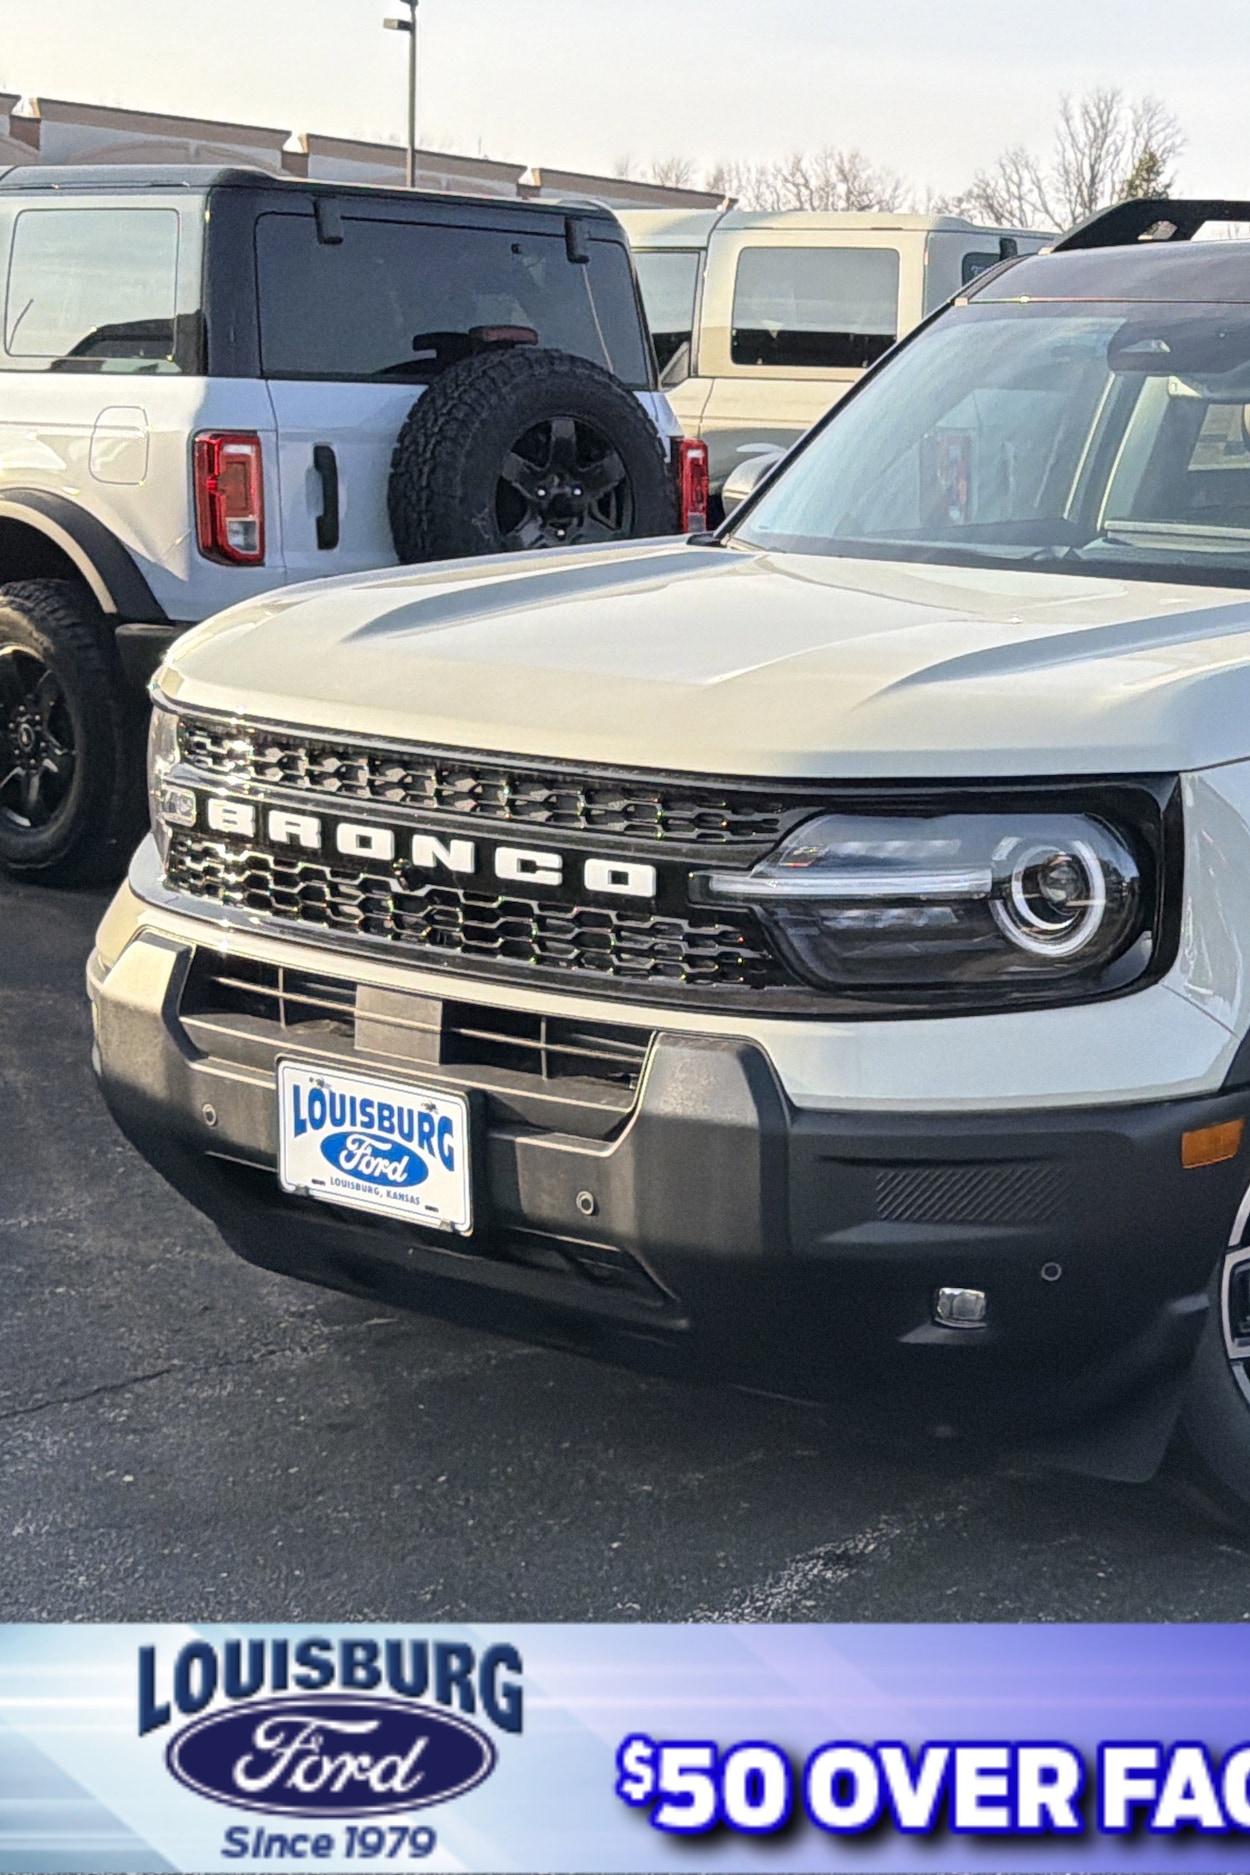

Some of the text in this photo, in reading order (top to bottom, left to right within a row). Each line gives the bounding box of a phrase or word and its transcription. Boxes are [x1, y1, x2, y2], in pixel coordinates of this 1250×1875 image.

[206, 797, 657, 898] BRONCO
[292, 1083, 455, 1172] LOUISBURG
[338, 1132, 410, 1183] Ford
[330, 1176, 421, 1206] LOUISBURG, KANSAS
